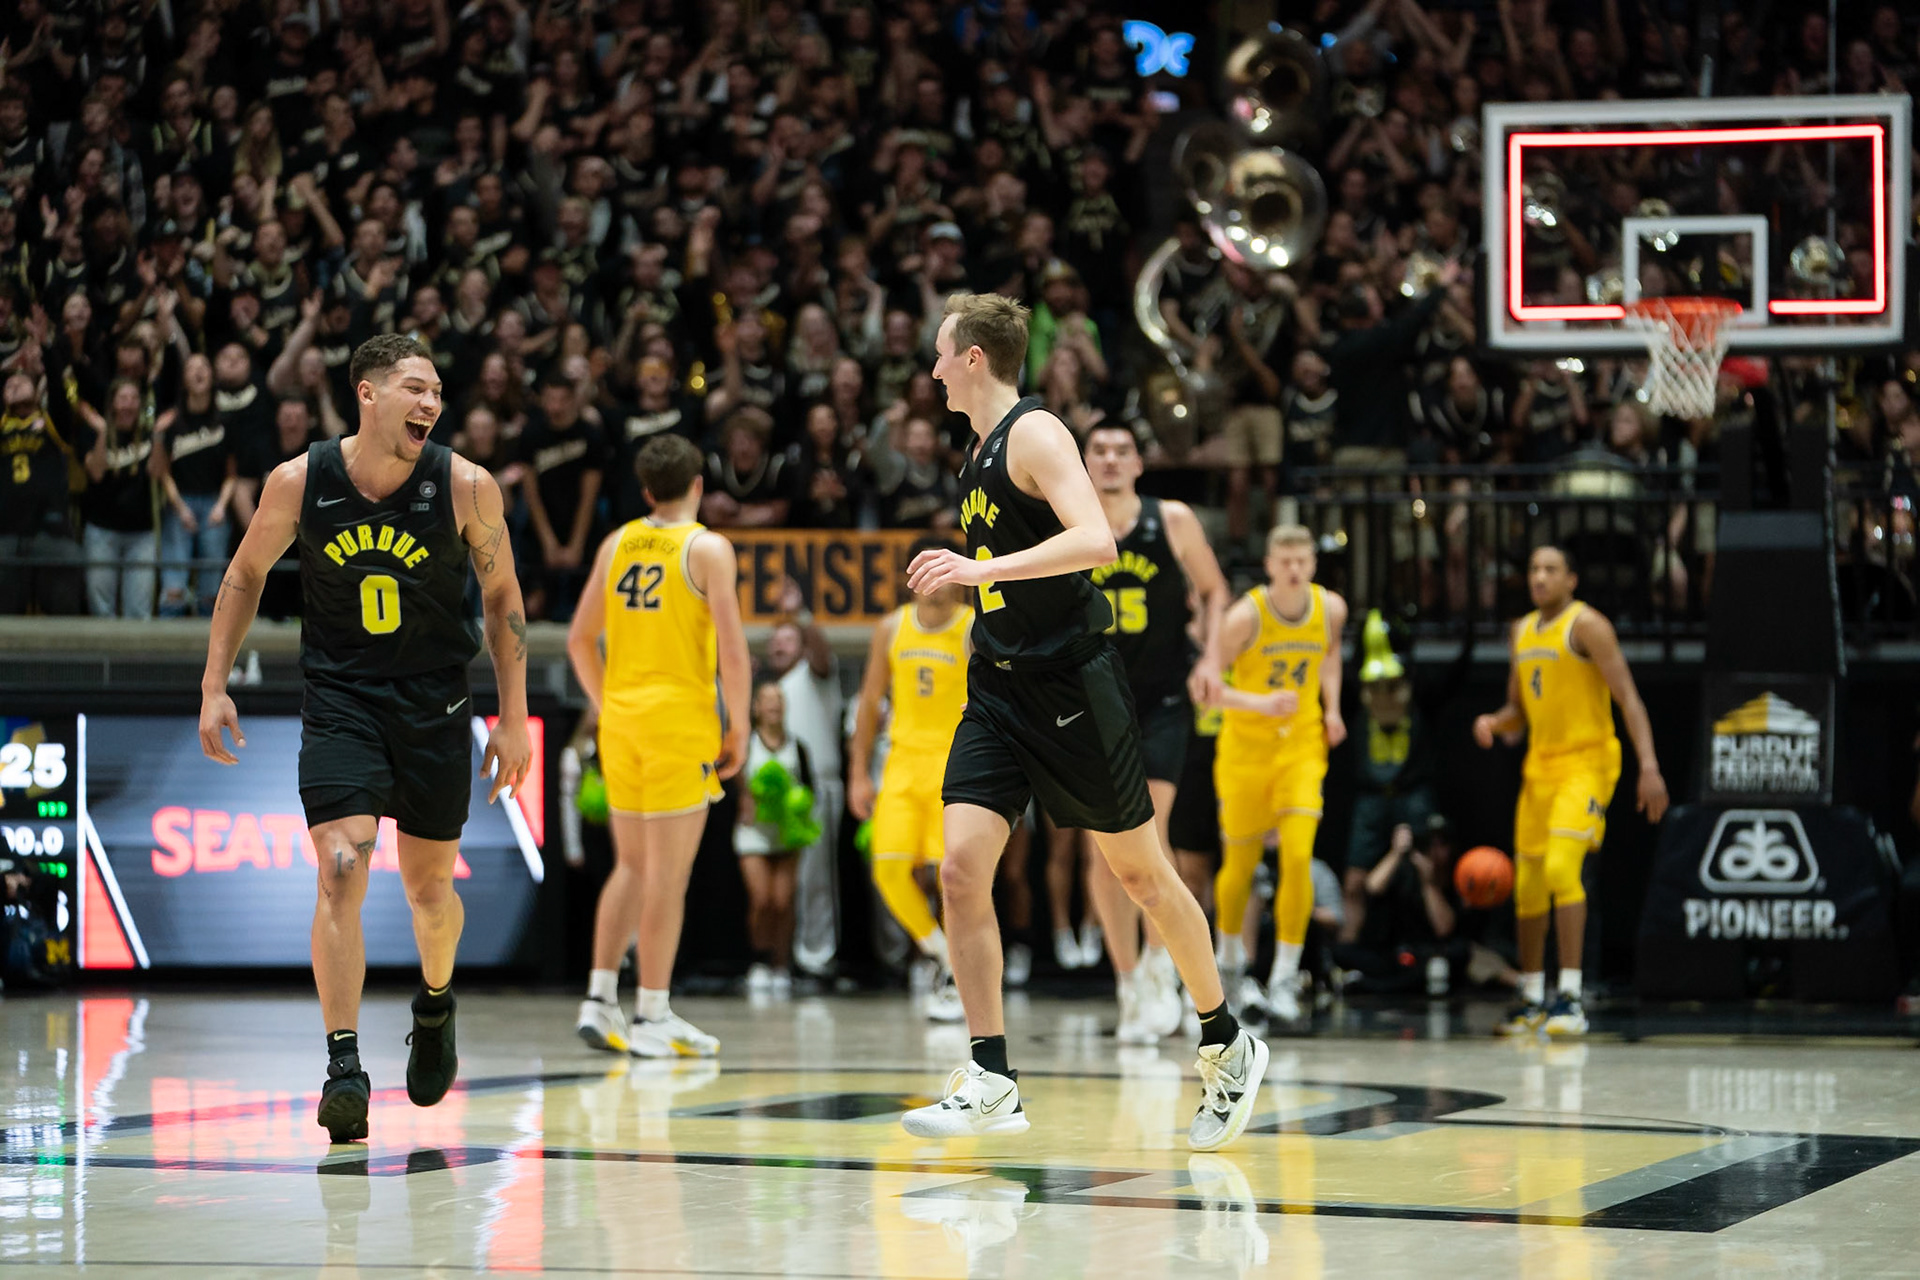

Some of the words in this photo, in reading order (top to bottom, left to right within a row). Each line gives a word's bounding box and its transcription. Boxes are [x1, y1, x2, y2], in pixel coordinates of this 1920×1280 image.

[323, 524, 430, 570] PURDUE
[360, 575, 402, 635] 0
[616, 564, 664, 609] 42
[918, 666, 935, 698] 5
[1267, 660, 1310, 688] 24
[0, 742, 68, 789] 25
[1712, 734, 1820, 757] PURDUE
[1684, 898, 1836, 940] PIONEER
